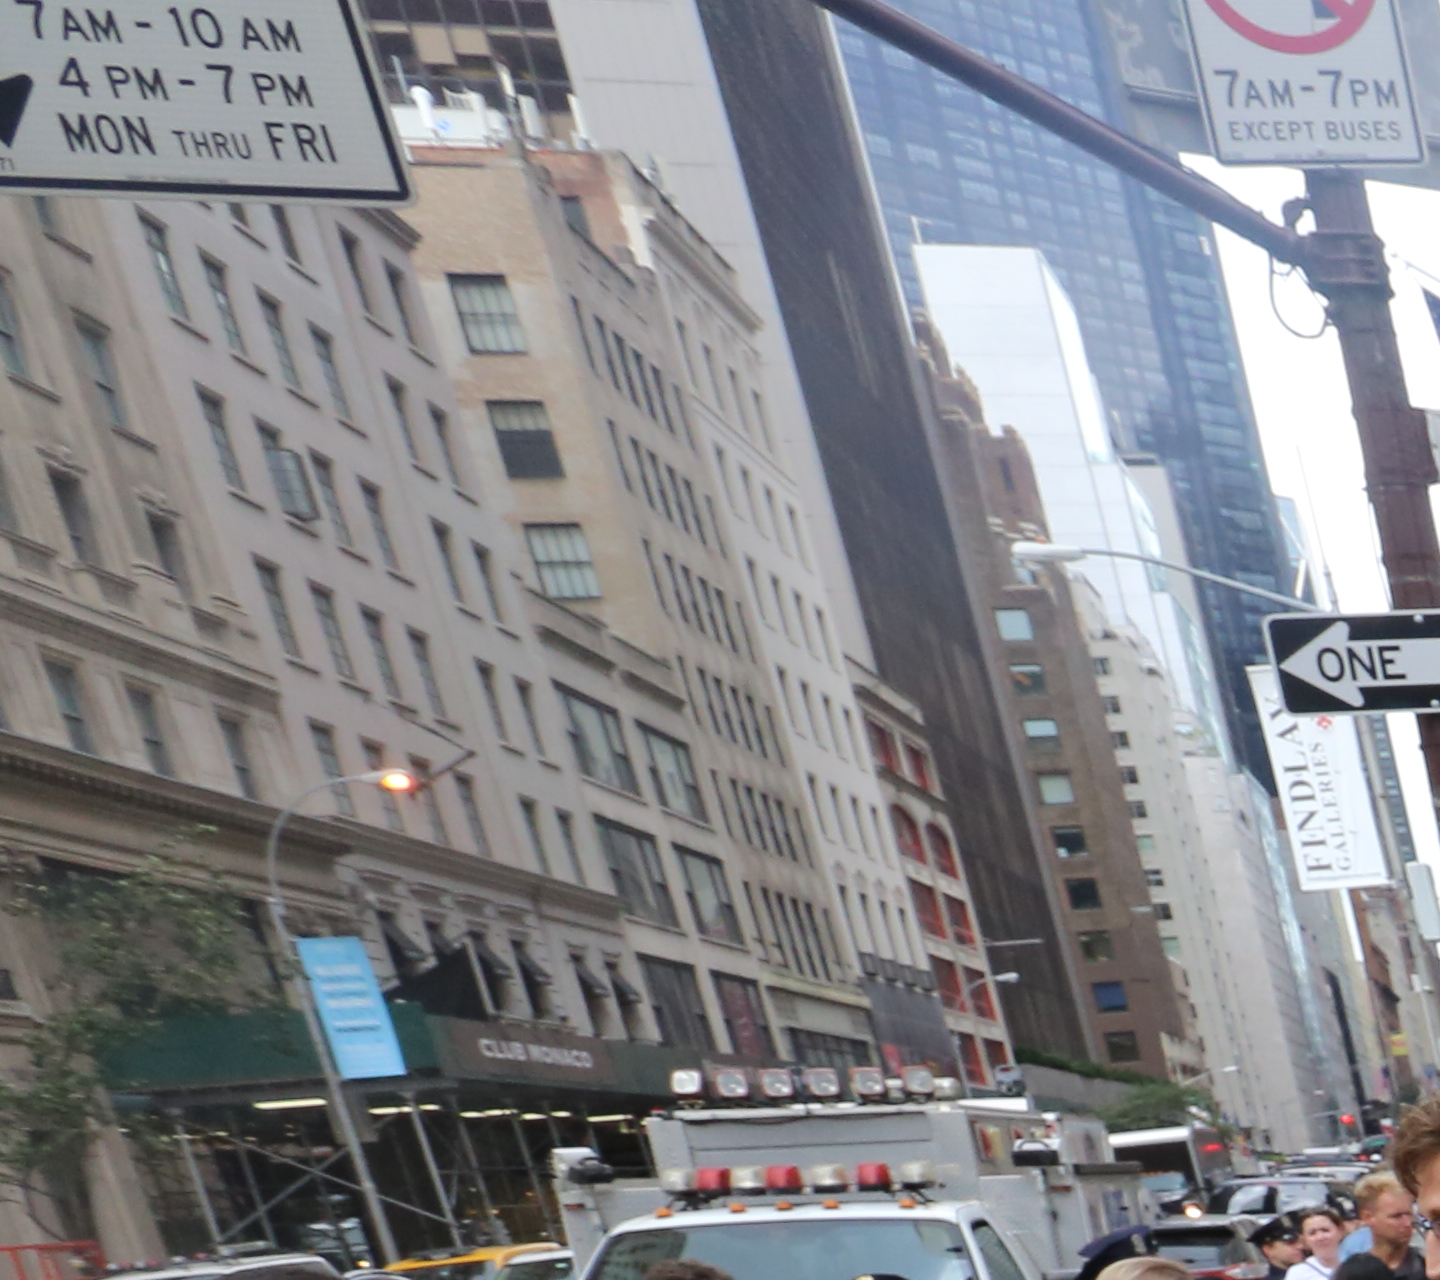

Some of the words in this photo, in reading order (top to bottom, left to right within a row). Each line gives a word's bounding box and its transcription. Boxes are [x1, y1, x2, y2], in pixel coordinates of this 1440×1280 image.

[62, 8, 123, 44] AM
[168, 7, 224, 49] 10
[242, 17, 302, 53] AM
[58, 57, 90, 98] 4
[104, 65, 170, 101] PM
[205, 63, 235, 104] 7
[250, 72, 316, 108] PM
[57, 112, 158, 156] MON
[172, 130, 253, 161] THRU
[264, 121, 338, 163] FRI
[1228, 120, 1315, 142] EXCEPT
[1326, 120, 1402, 142] BUSES
[1316, 644, 1407, 683] ONE
